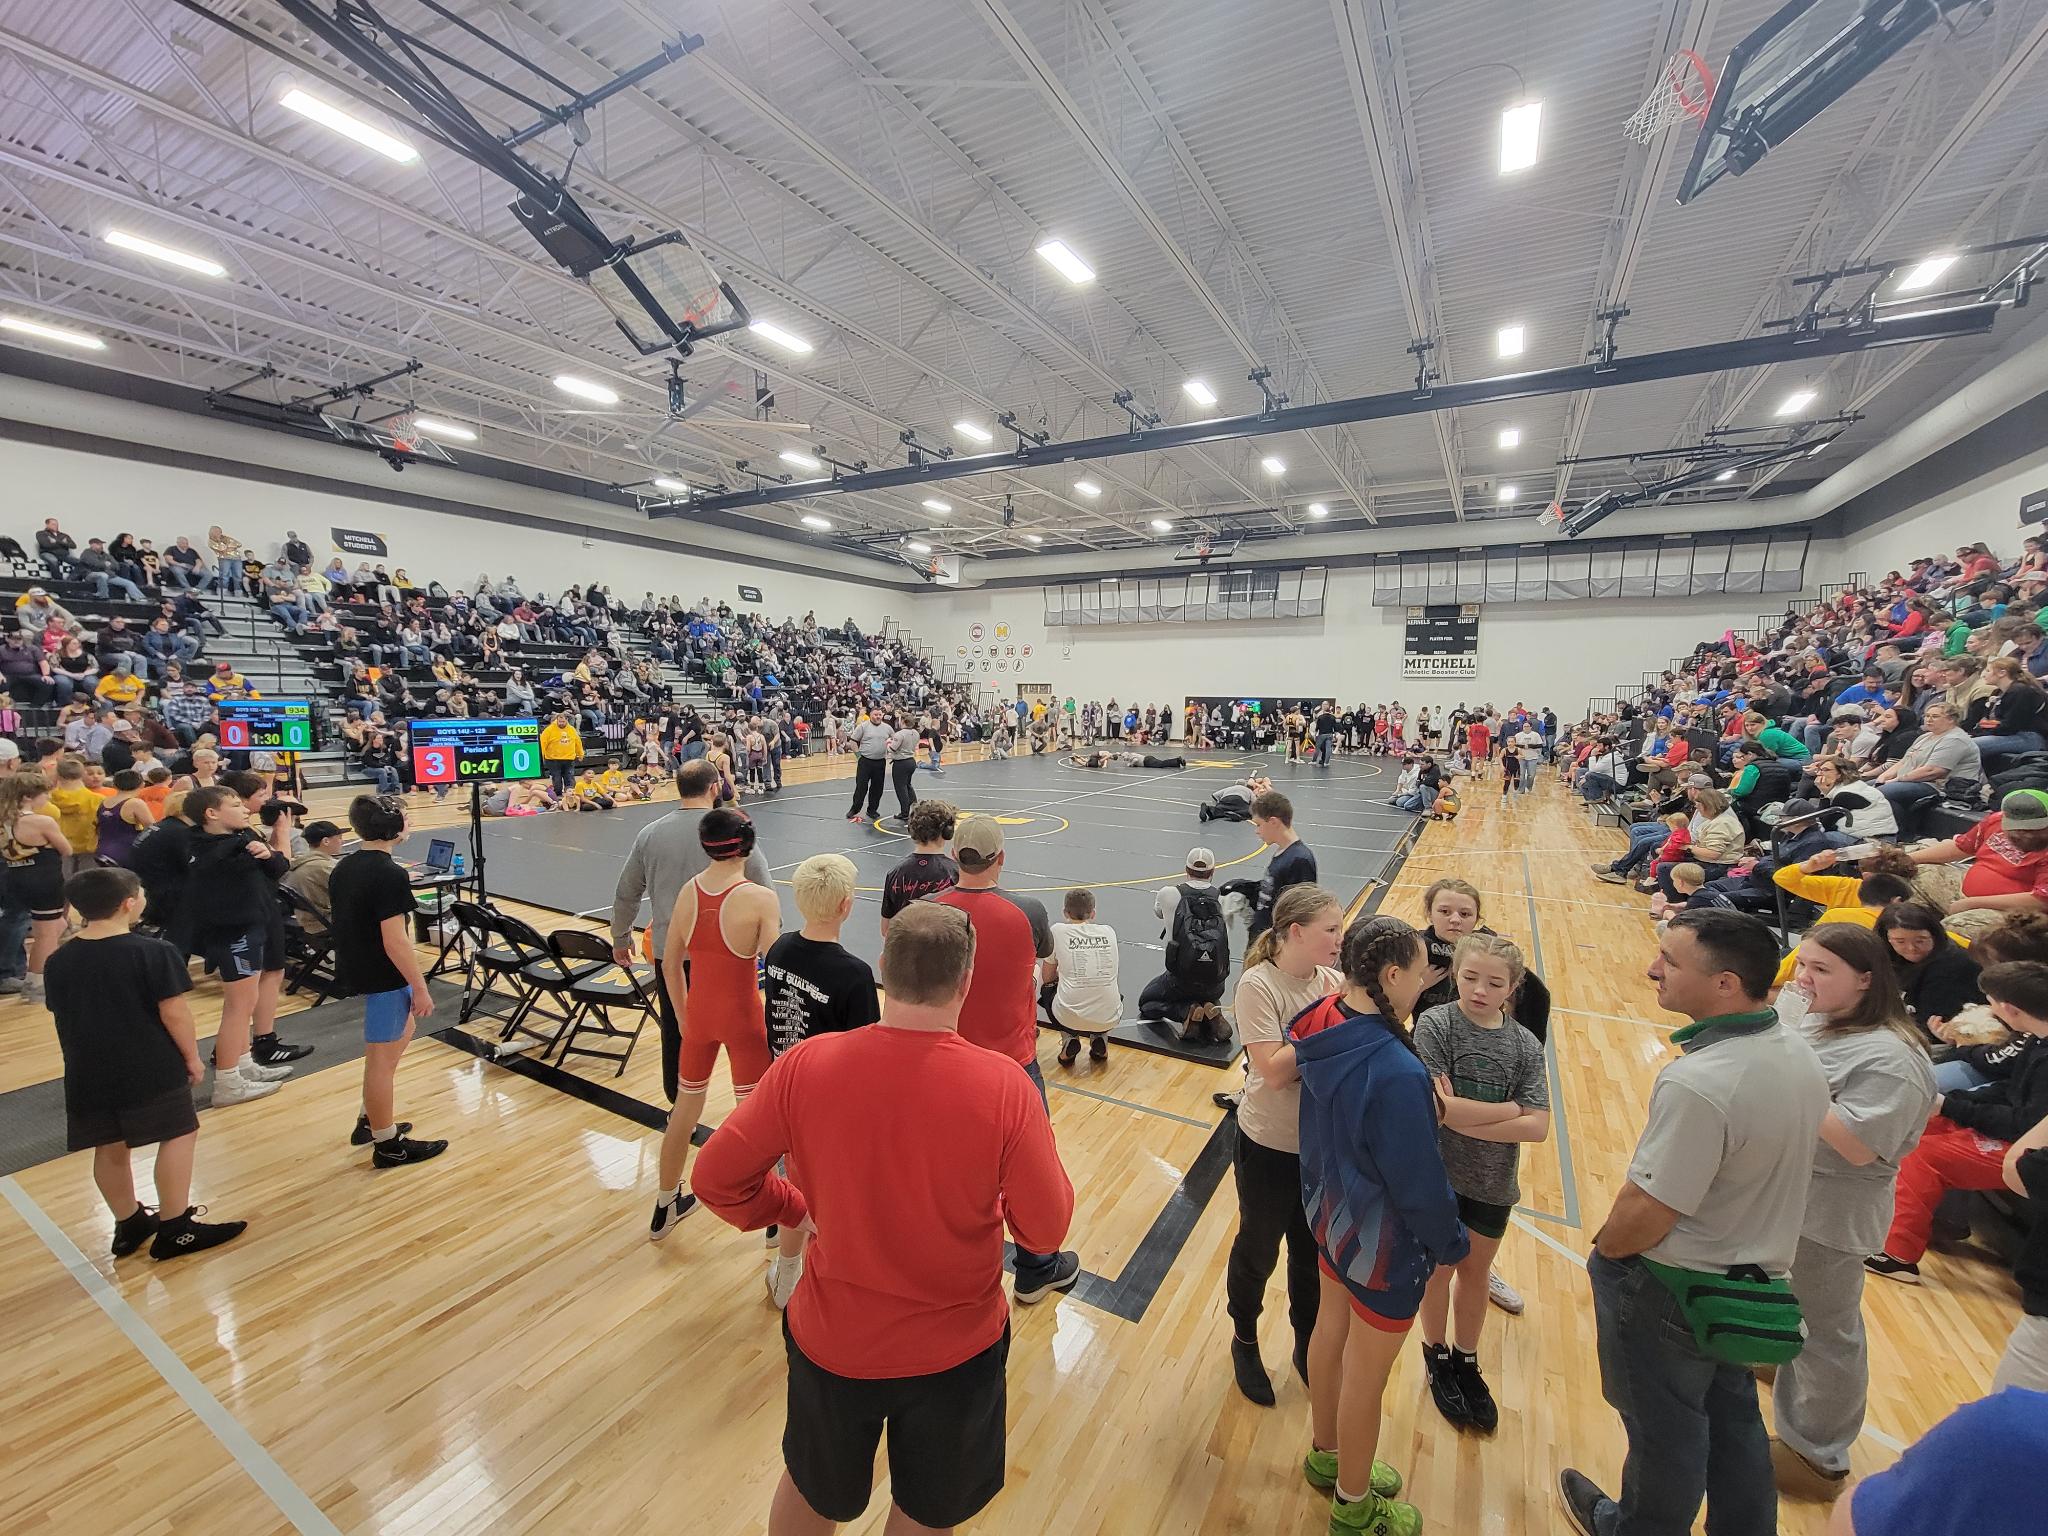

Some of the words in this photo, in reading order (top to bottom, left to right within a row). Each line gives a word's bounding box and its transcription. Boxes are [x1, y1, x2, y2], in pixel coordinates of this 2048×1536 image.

[343, 534, 376, 544] MITCHELL
[343, 541, 377, 551] STUDENTS
[1404, 658, 1476, 669] MITCHELL
[227, 725, 242, 745] 0
[289, 725, 303, 746] 0
[508, 726, 537, 734] 1032
[251, 733, 280, 745] 1:30
[425, 752, 446, 777] 3
[459, 759, 500, 775] 0:47
[513, 749, 530, 772] 0
